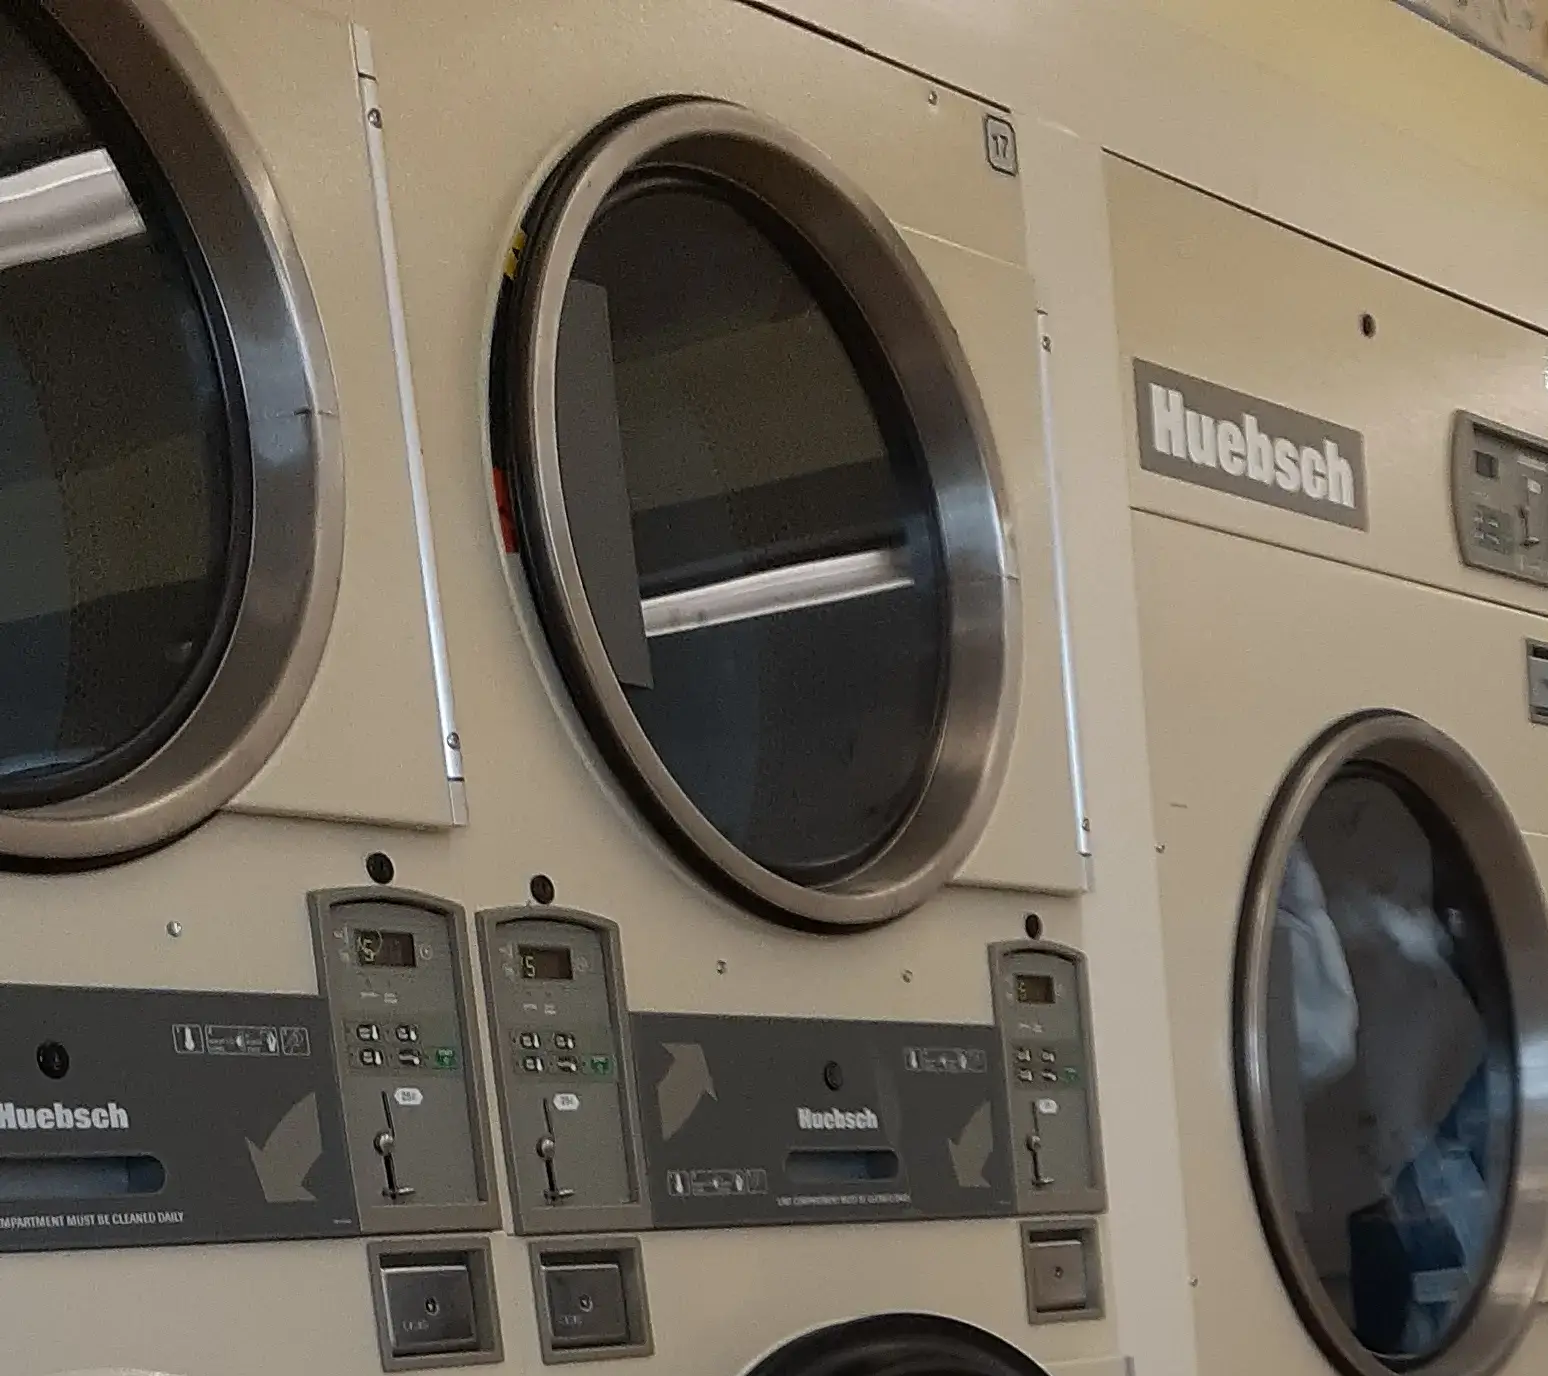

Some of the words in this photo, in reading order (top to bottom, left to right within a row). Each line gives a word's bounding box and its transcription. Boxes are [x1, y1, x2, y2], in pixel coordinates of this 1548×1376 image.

[991, 133, 1009, 159] 17
[1149, 383, 1356, 509] Huebsch
[523, 955, 536, 978] 5
[0, 1101, 129, 1129] Huebsch
[797, 1106, 879, 1130] Huebsch
[66, 1213, 95, 1227] MUST
[97, 1213, 110, 1226] BE
[112, 1211, 156, 1225] CLEANED
[157, 1210, 184, 1224] DAILY
